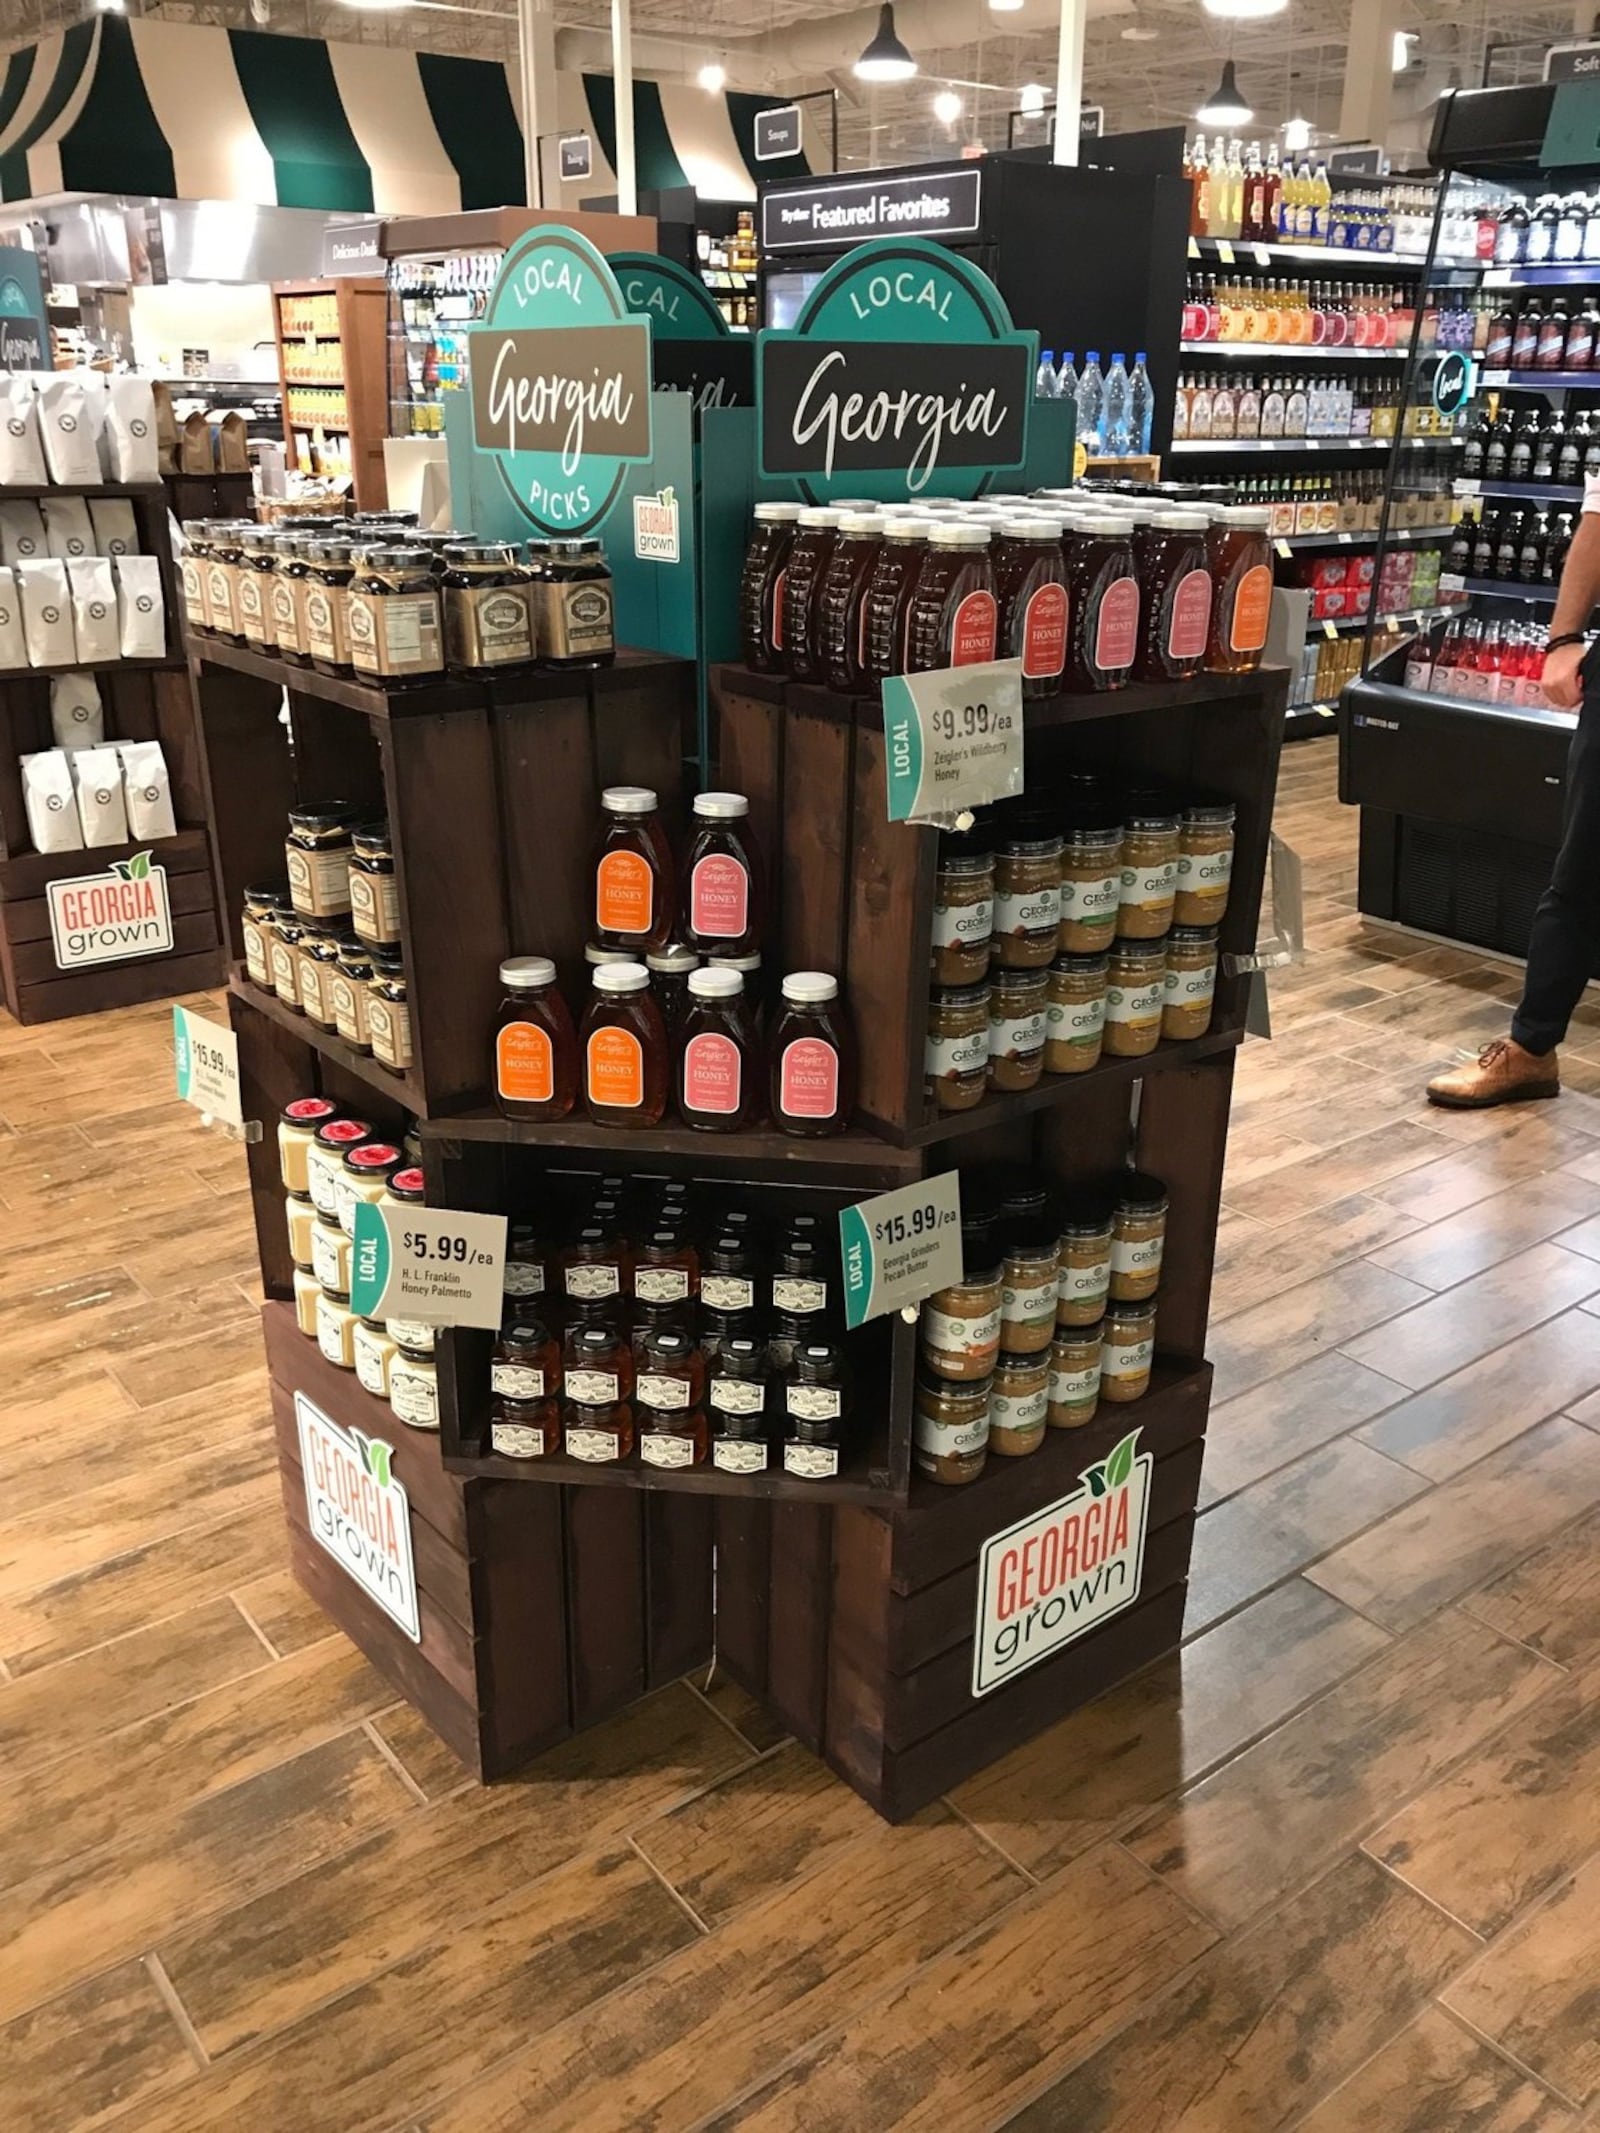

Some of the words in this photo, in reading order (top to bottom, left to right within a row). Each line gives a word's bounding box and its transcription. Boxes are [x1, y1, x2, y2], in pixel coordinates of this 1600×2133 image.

[812, 196, 875, 229] Featured
[879, 193, 950, 222] Favorites
[333, 243, 360, 260] Delicious
[513, 258, 582, 309] LOCAL
[626, 280, 680, 322] CAL
[849, 272, 953, 323] LOCAL
[488, 338, 634, 478] Georgia
[792, 350, 1008, 493] Georgia
[530, 479, 591, 520] PICKS
[639, 505, 673, 535] GEORGIA
[639, 535, 675, 551] grown
[961, 638, 990, 649] HONEY
[1032, 629, 1062, 640] HONEY
[932, 703, 1012, 740] $9.99/ea
[893, 719, 911, 778] LOCAL
[934, 747, 969, 766] Zeigler's
[934, 768, 960, 782] Honey
[62, 880, 157, 931] GEORGIA
[606, 888, 643, 901] HONEY
[701, 893, 738, 904] HONEY
[1019, 902, 1059, 919] GEORGI
[68, 921, 160, 956] grown
[177, 1036, 188, 1073] LOCAL
[193, 1040, 236, 1080] $15.99/ea
[505, 1059, 543, 1070] HONEY
[596, 1064, 634, 1075] HONEY
[693, 1070, 732, 1081] HONEY
[790, 1075, 829, 1086] HONEY
[875, 1205, 957, 1245] $15.99/ea
[359, 1238, 378, 1282] LOCAL
[403, 1231, 493, 1265] $5.99/ea
[848, 1240, 863, 1291] LOCAL
[883, 1252, 910, 1270] Georgia
[911, 1241, 940, 1259] Grinders
[402, 1268, 412, 1279] H.
[414, 1269, 423, 1280] L.
[424, 1271, 461, 1284] Franklin
[884, 1268, 906, 1284] Pecan
[907, 1259, 929, 1275] Butter
[401, 1282, 430, 1297] Honey
[431, 1284, 472, 1299] Palmetto
[309, 1424, 401, 1567] GEORGIA
[317, 1498, 405, 1606] grown
[996, 1486, 1128, 1622] GEORGIA
[994, 1559, 1126, 1666] grown
